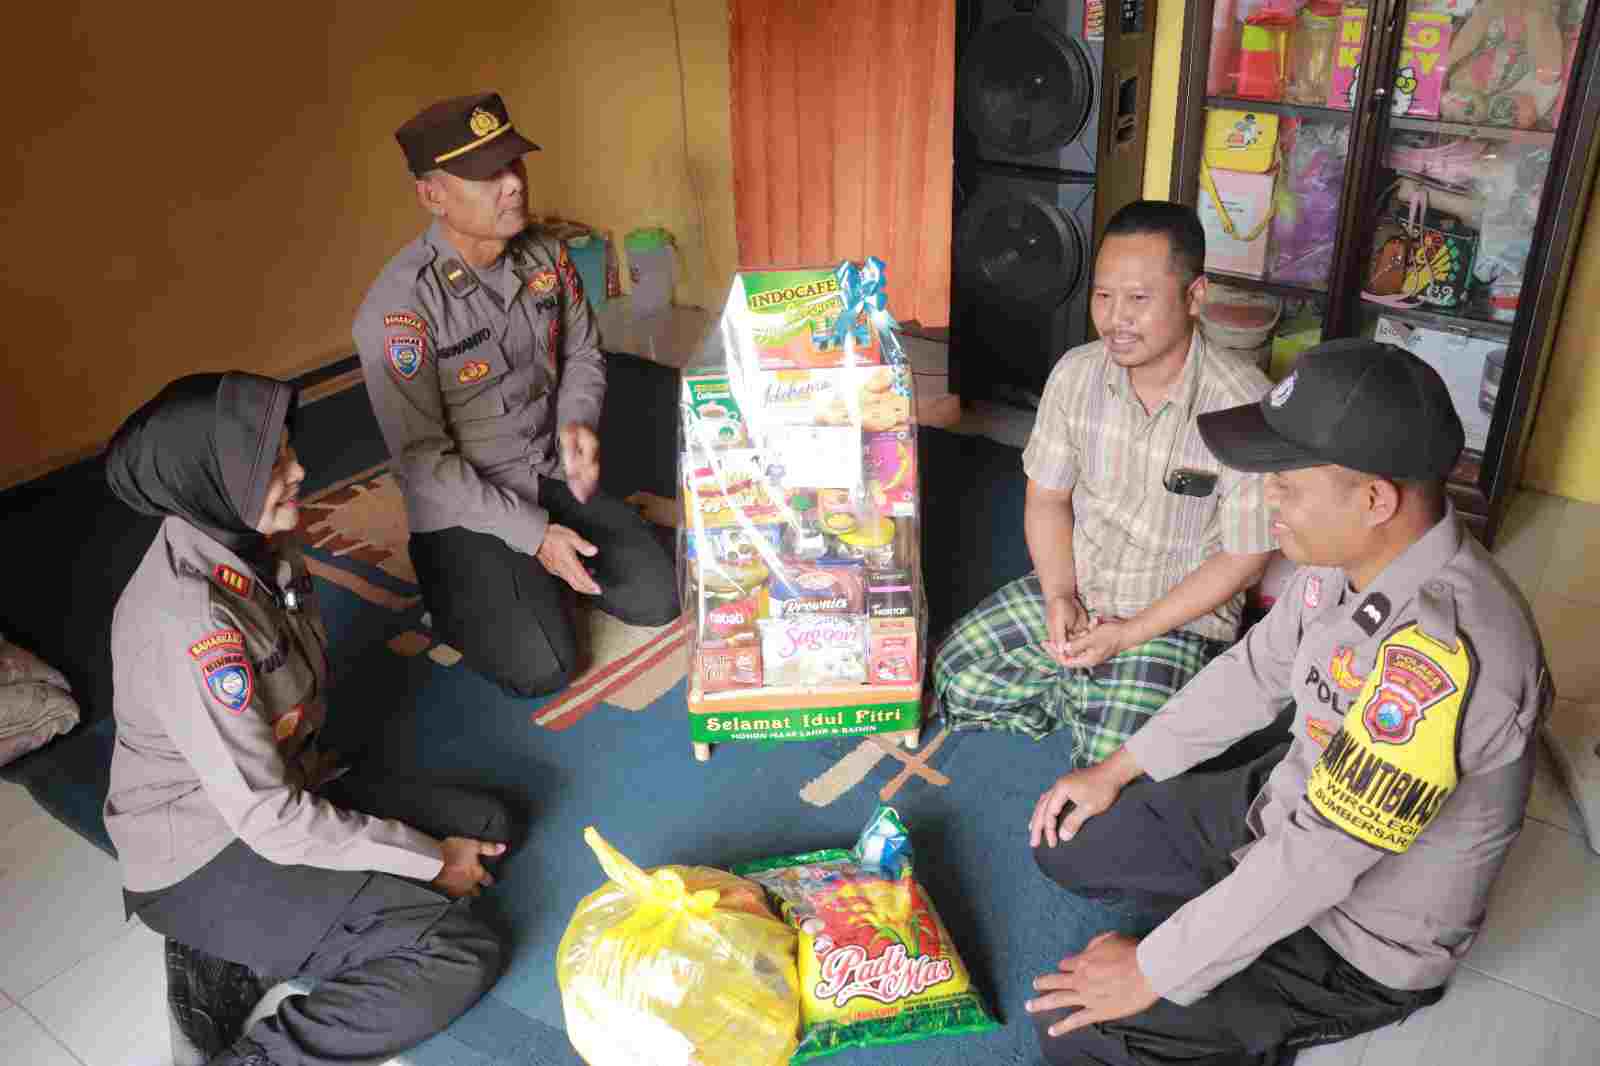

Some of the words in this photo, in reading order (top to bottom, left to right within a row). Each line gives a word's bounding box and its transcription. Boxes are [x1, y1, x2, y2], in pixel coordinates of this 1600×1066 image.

[751, 279, 838, 308] INDOCAFE
[706, 716, 791, 732] Selamat
[800, 711, 843, 728] Idul
[855, 708, 902, 724] Fitri
[815, 944, 906, 1007] Padi
[879, 954, 954, 1004] Mas
